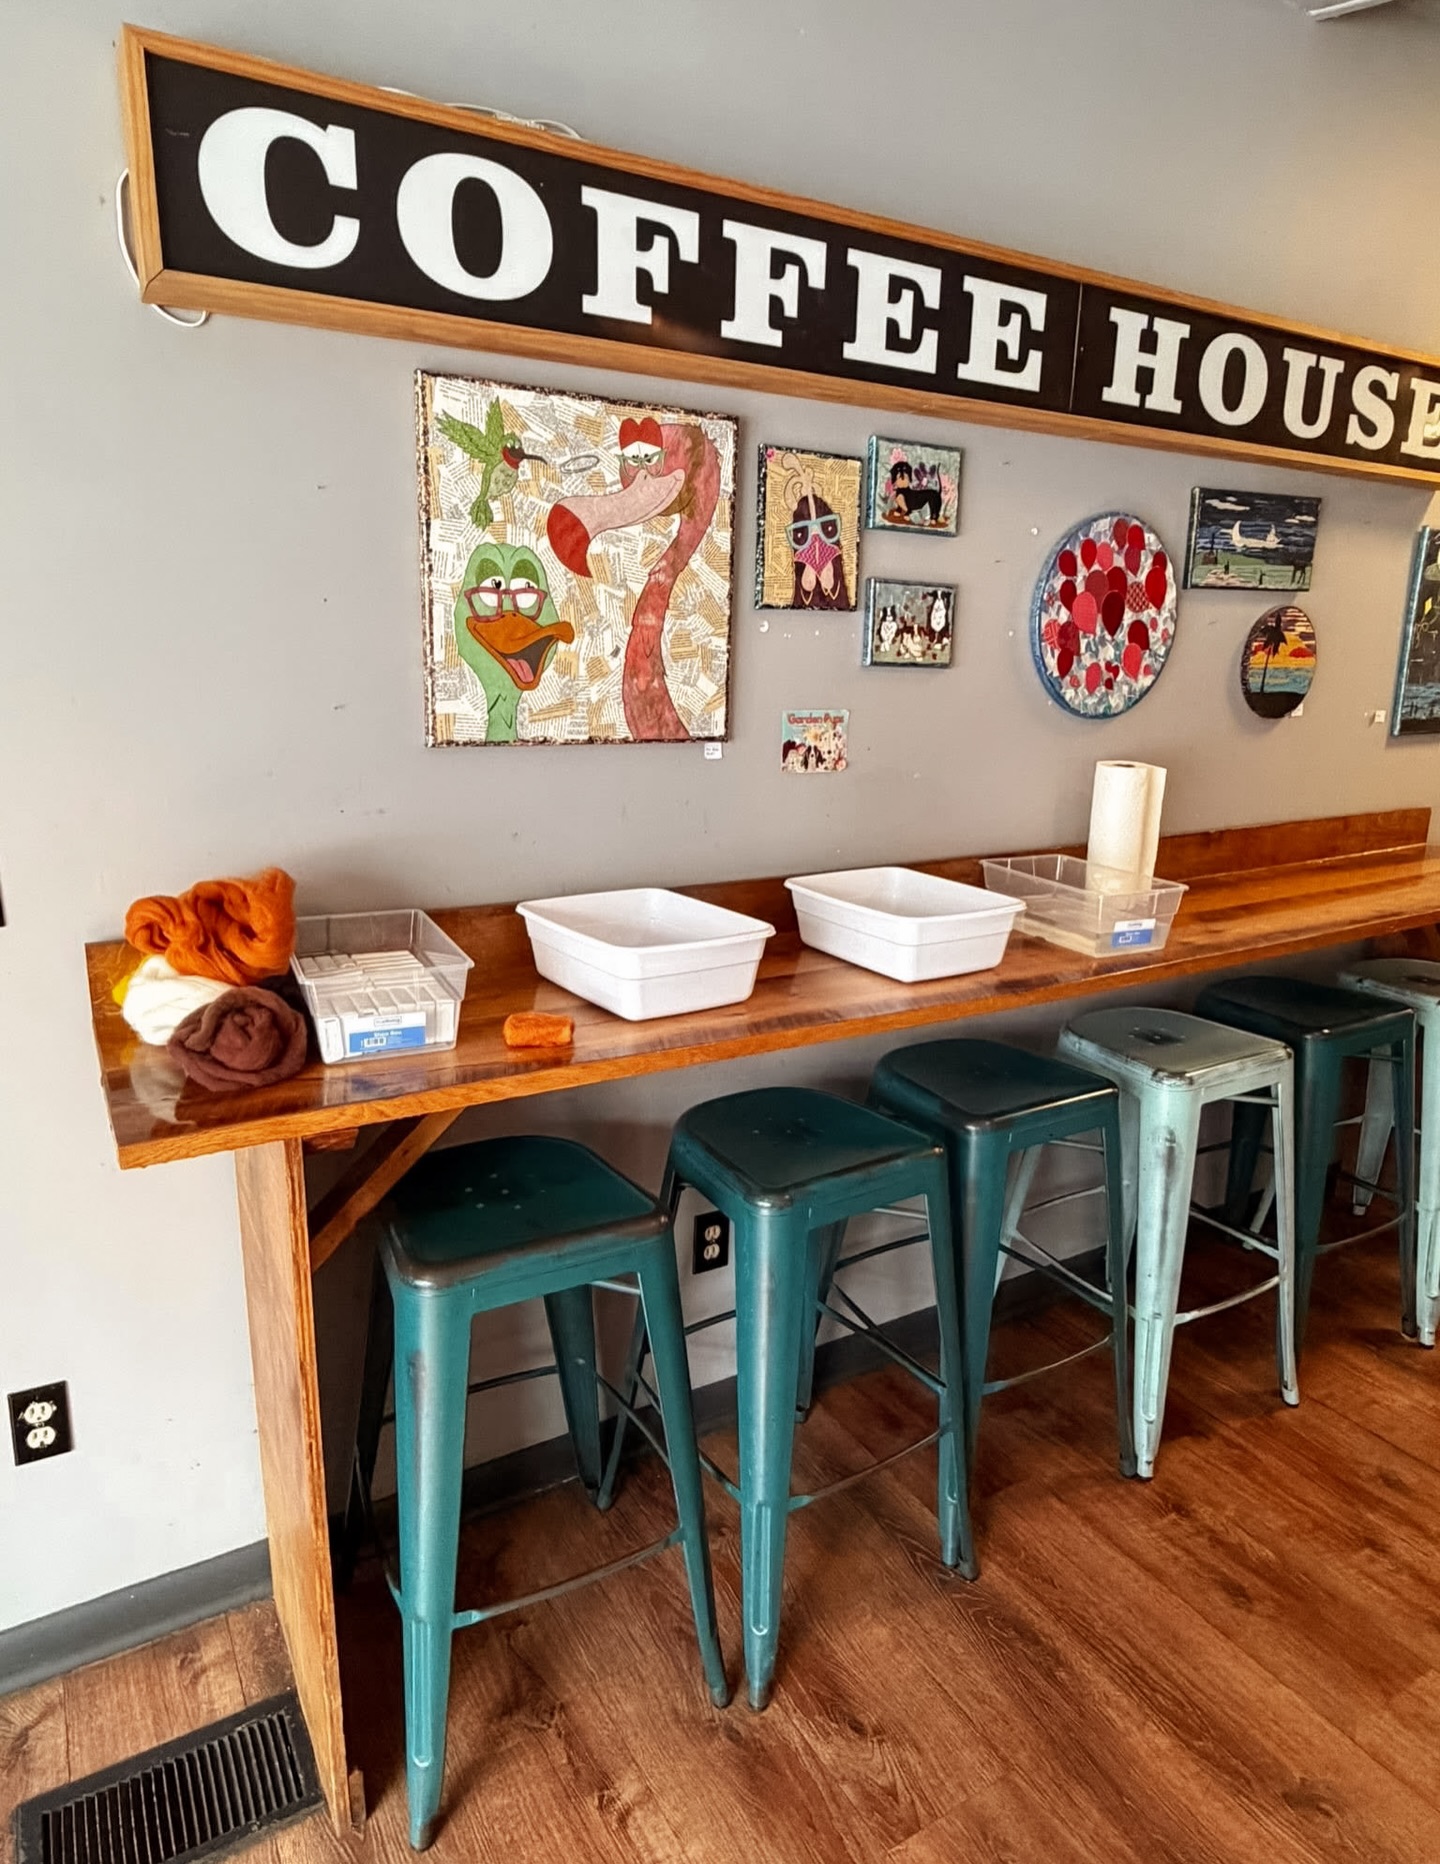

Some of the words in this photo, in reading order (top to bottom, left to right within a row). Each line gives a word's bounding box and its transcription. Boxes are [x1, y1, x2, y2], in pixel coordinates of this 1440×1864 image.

[198, 106, 1048, 393] COFFEE
[1102, 305, 1440, 460] HOUSE
[787, 713, 822, 724] Garden
